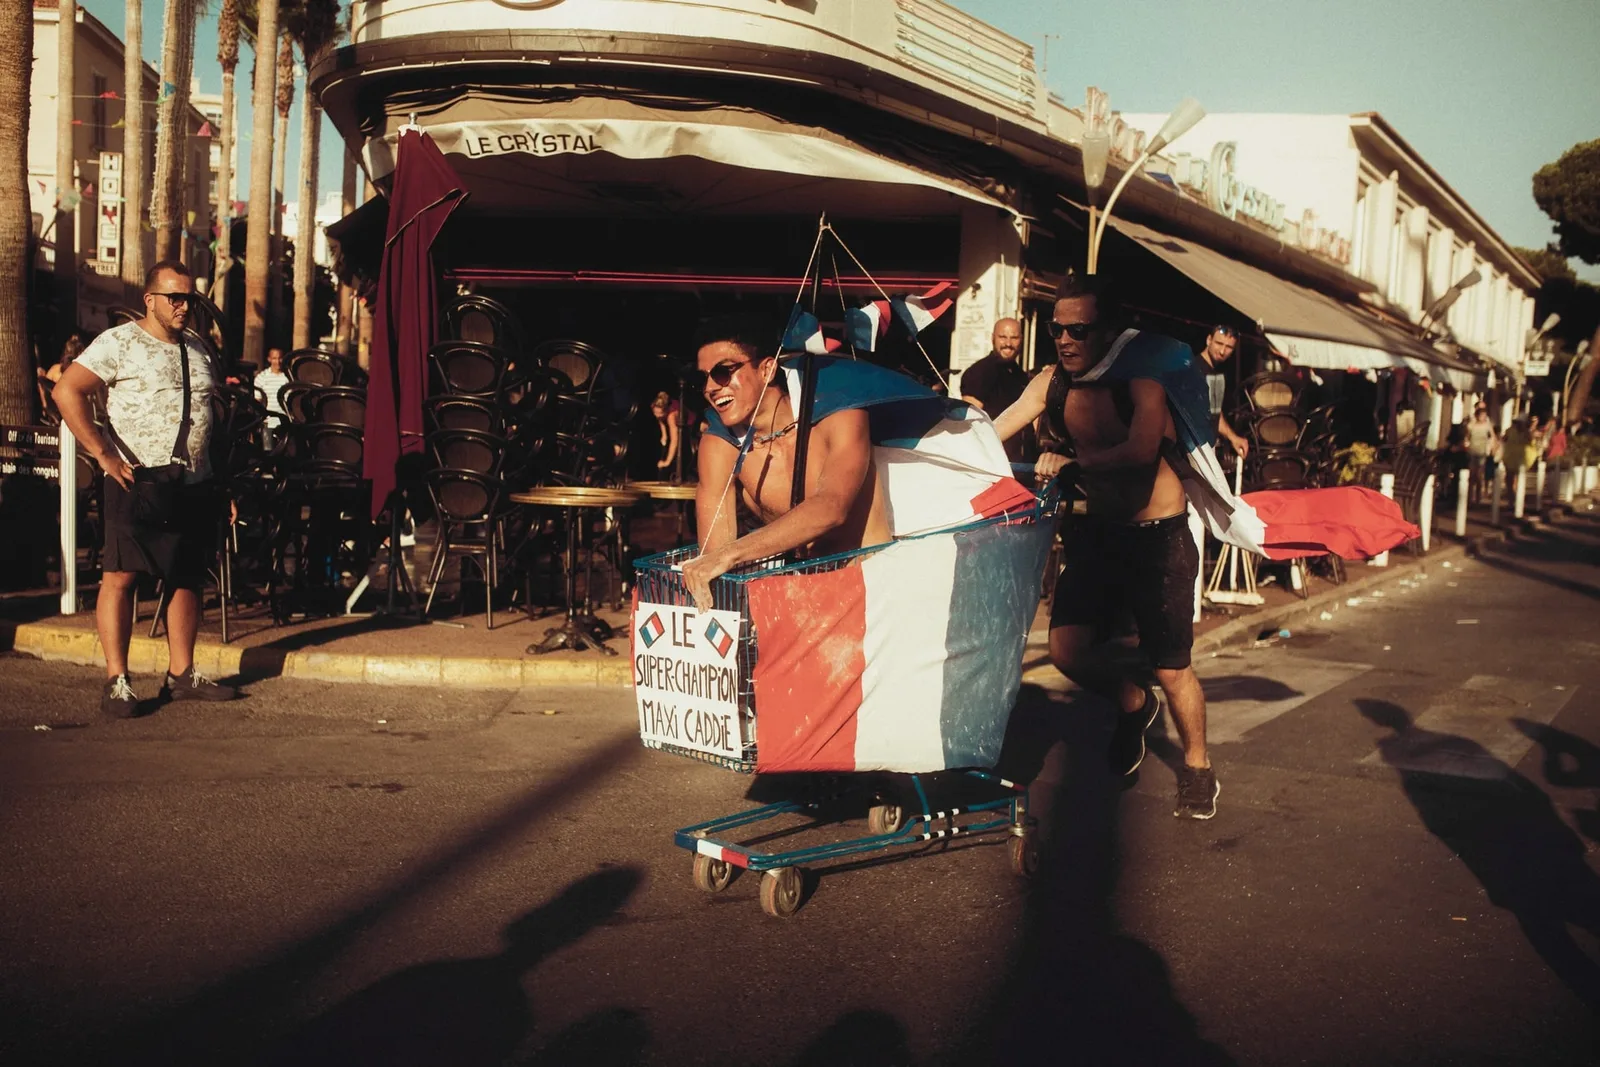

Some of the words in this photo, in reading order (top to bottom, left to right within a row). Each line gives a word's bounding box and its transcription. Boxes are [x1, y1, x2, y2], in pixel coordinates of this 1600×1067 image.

[466, 137, 493, 156] LE
[497, 131, 602, 154] CRYSTAL
[101, 154, 119, 262] HOTEL
[34, 432, 58, 445] Tourisme
[33, 465, 58, 479] congrès
[671, 611, 696, 648] LE
